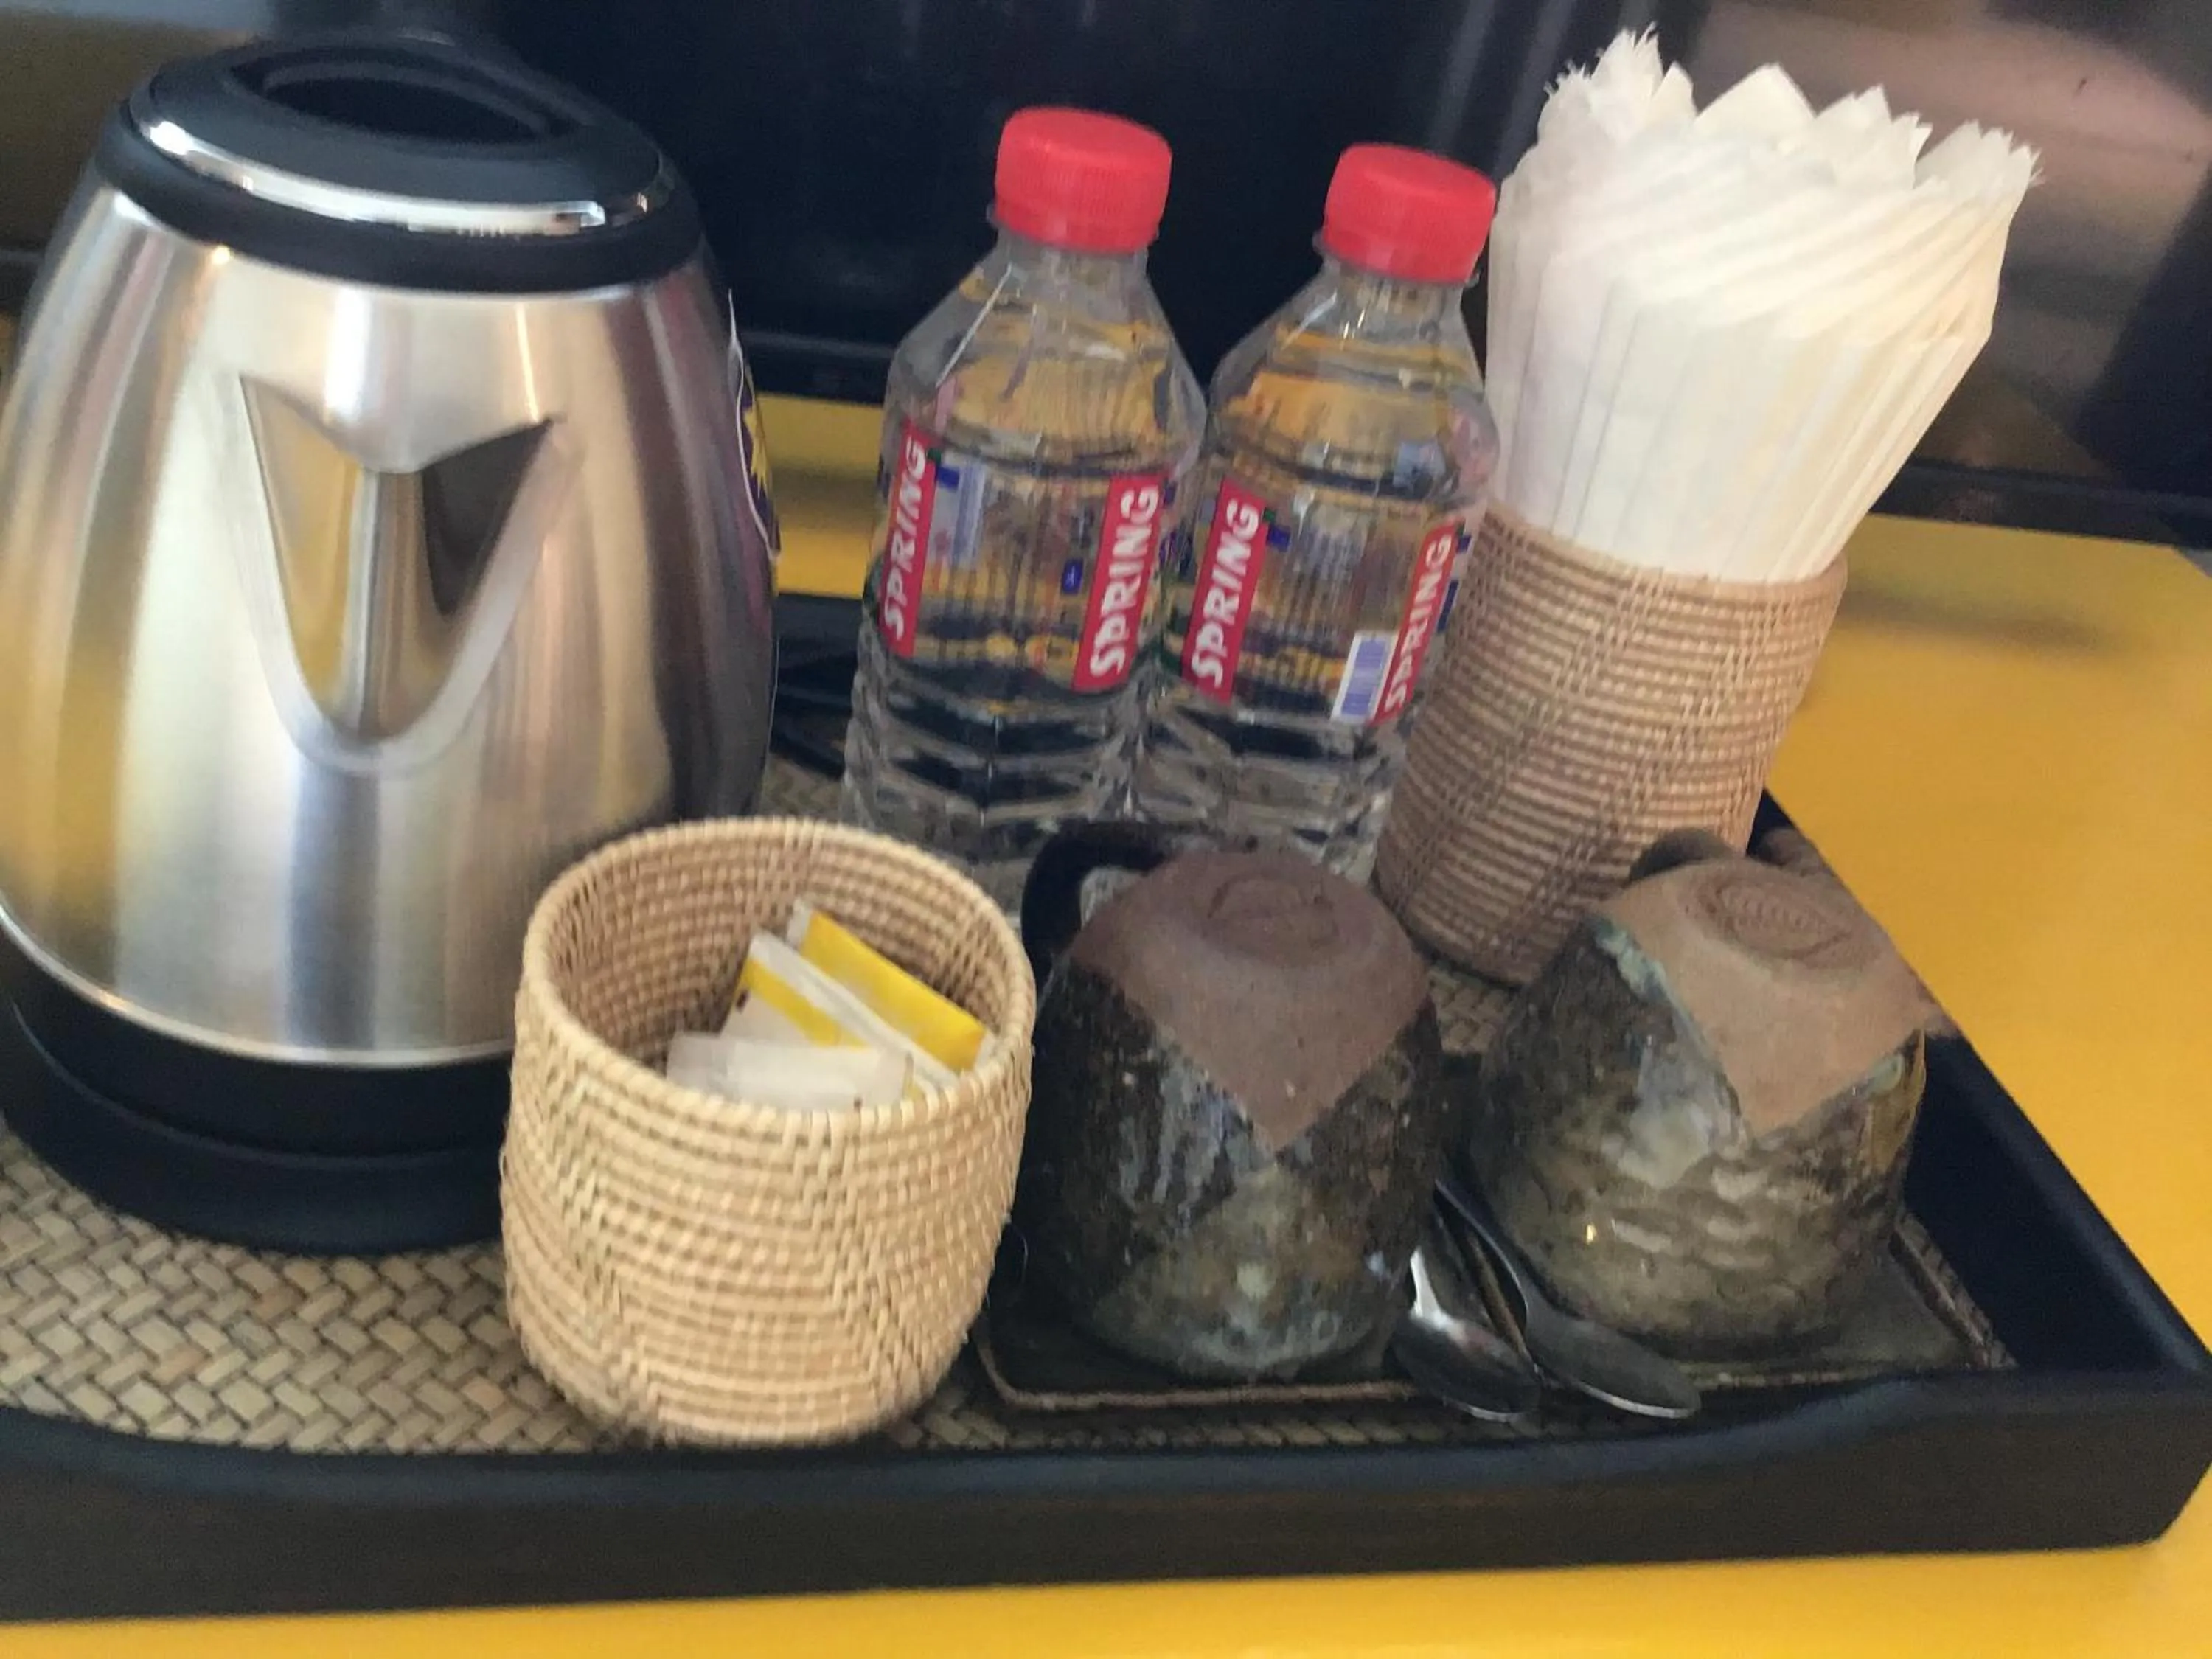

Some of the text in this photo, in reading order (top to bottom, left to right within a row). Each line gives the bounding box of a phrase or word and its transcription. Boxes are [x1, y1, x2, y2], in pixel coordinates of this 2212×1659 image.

[885, 437, 926, 641] SPRING
[1089, 484, 1159, 678] SPRING
[1191, 498, 1259, 689] SPRING
[1383, 534, 1453, 713] SPRING
